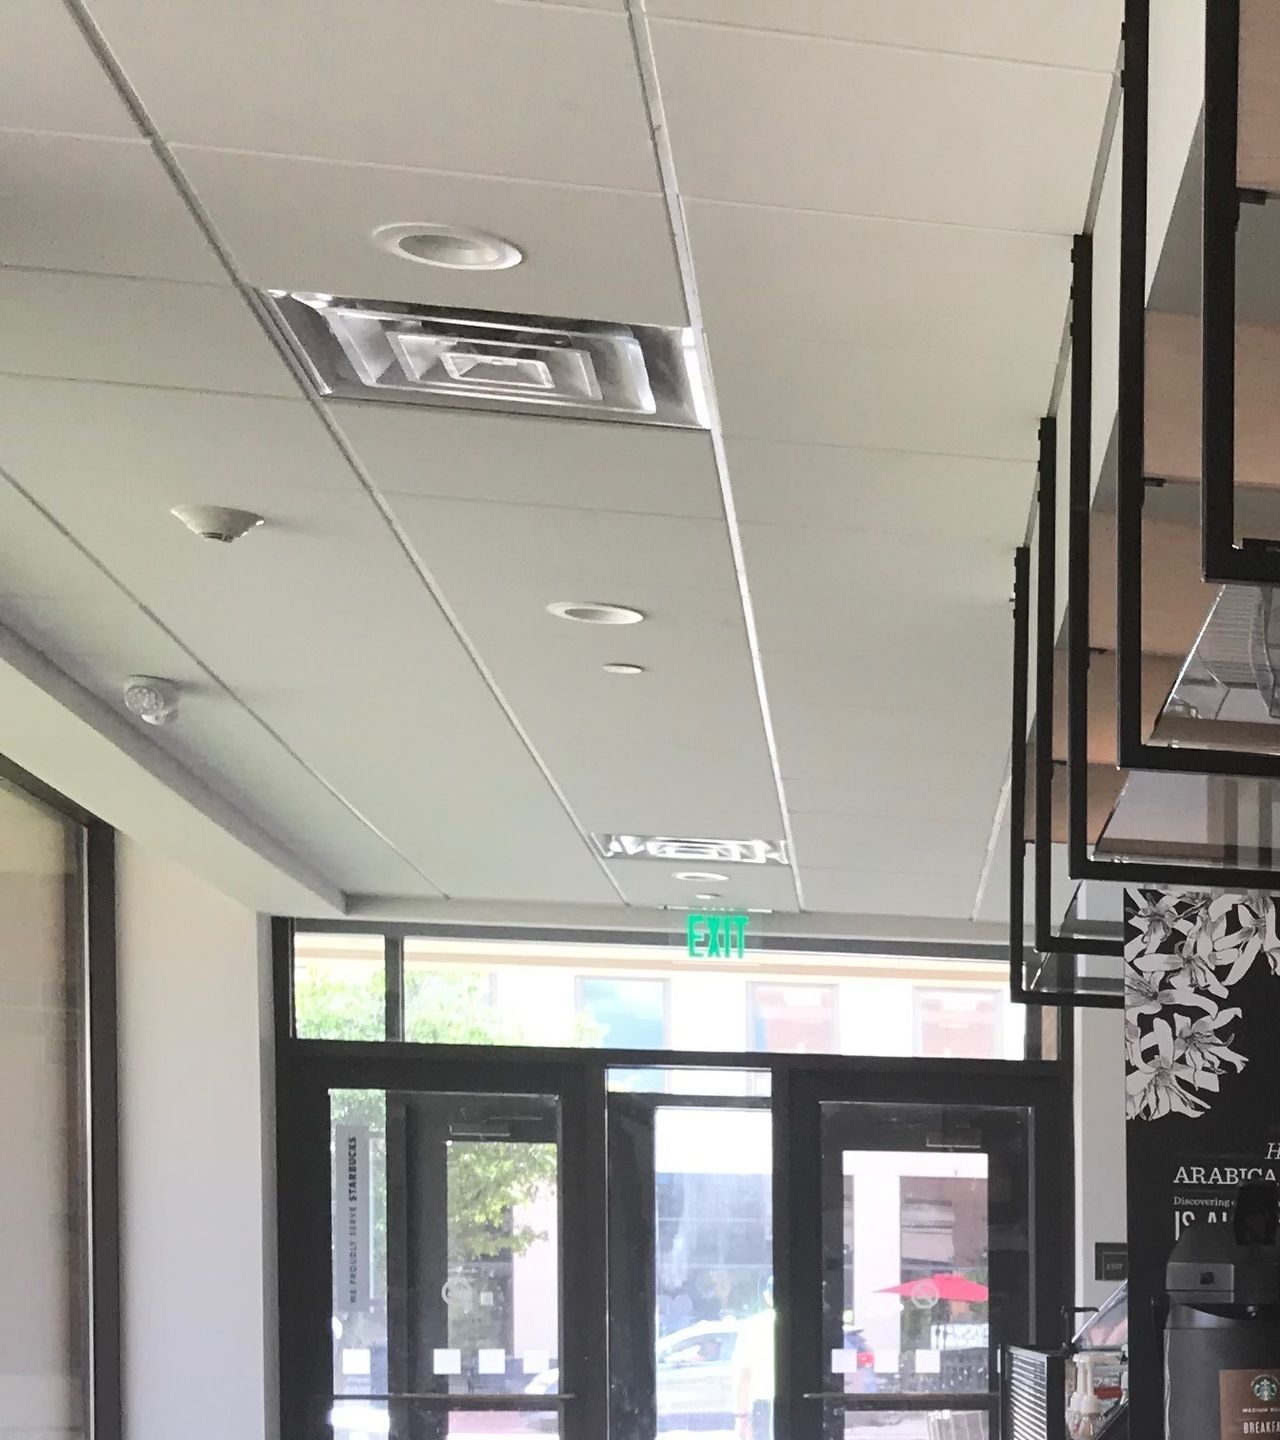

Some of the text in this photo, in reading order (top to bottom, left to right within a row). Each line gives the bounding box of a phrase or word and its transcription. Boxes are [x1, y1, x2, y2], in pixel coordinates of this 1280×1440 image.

[687, 913, 750, 959] EXIT
[348, 1136, 358, 1202] STARBUCKS
[348, 1206, 358, 1237] SERVE
[1173, 1196, 1232, 1209] Discovering
[349, 1241, 358, 1285] PROUDLY
